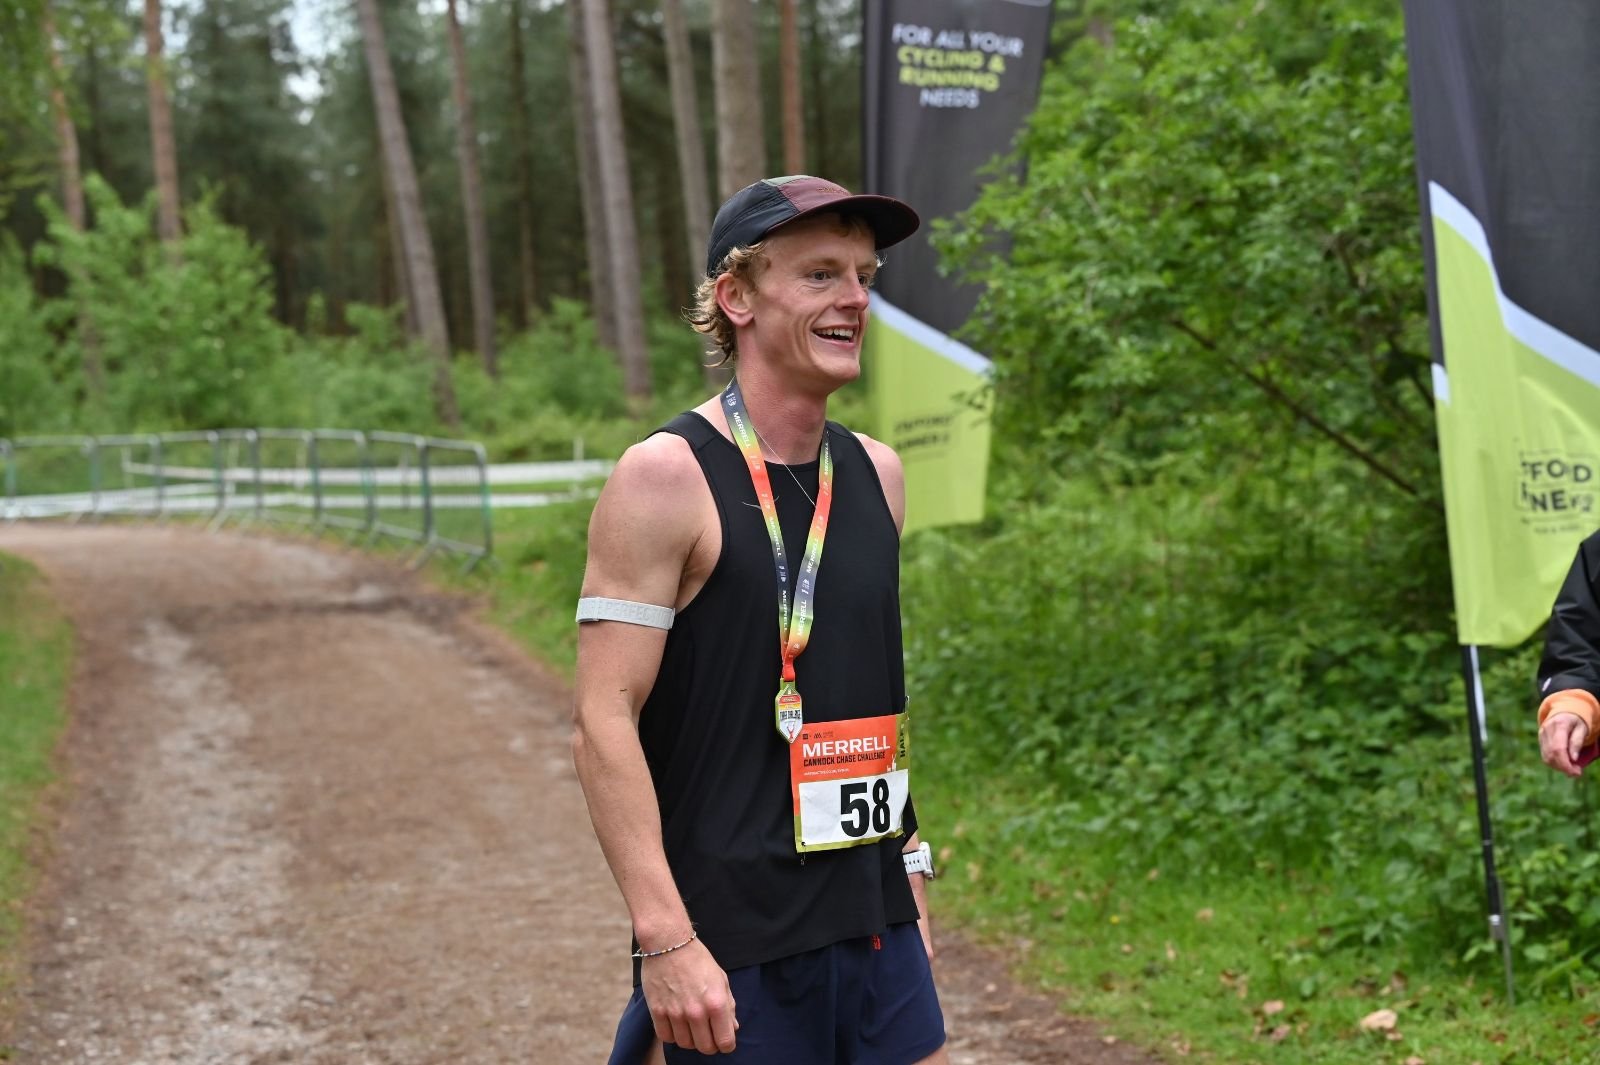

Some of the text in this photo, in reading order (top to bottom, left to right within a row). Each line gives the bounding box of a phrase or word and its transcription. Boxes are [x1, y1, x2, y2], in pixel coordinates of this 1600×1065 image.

[892, 23, 1025, 58] FOR ALL YOUR
[897, 45, 985, 70] CYCLING
[899, 65, 999, 92] RUNNING
[919, 87, 980, 109] NEEDS
[733, 411, 752, 448] MERRELL
[802, 736, 891, 758] MERRELL
[803, 751, 886, 767] CANNOCK CHASE CHALLENGE
[840, 778, 891, 837] 58
